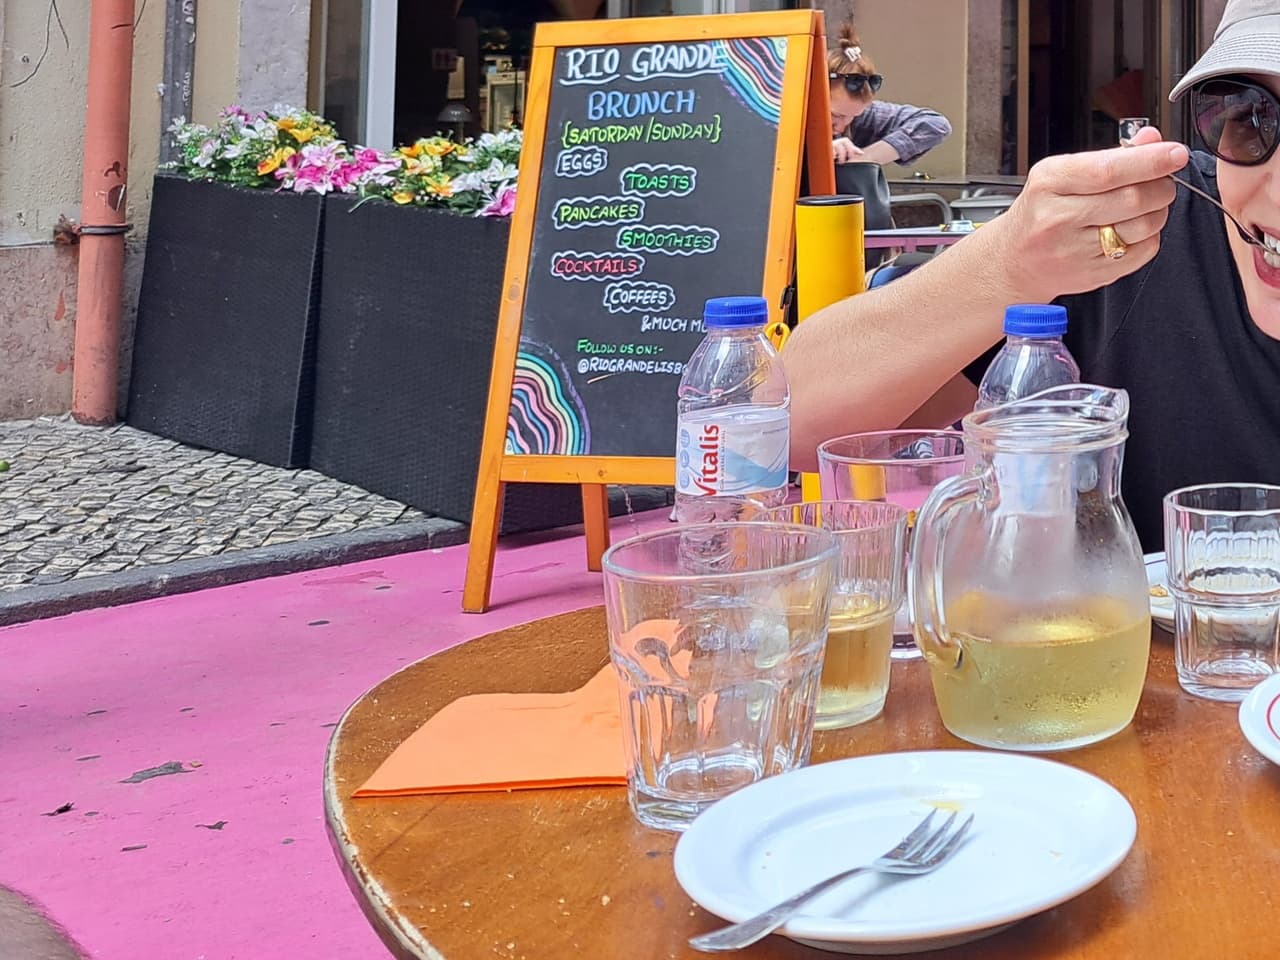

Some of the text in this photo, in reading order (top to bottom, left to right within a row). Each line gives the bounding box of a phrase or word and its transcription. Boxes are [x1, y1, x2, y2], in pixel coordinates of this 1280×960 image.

[566, 43, 729, 79] RIO GRANDE
[587, 89, 696, 121] BRUNCH
[561, 152, 602, 171] EGGS
[625, 173, 690, 190] TOASTS
[560, 204, 639, 222] PANCAKES
[621, 231, 712, 249] SMOOTHIES
[555, 257, 638, 273] COCKTAILS
[609, 288, 667, 305] COFFEES
[576, 339, 616, 354] FOLLOW
[619, 343, 634, 354] US
[692, 424, 719, 497] Vitalis
